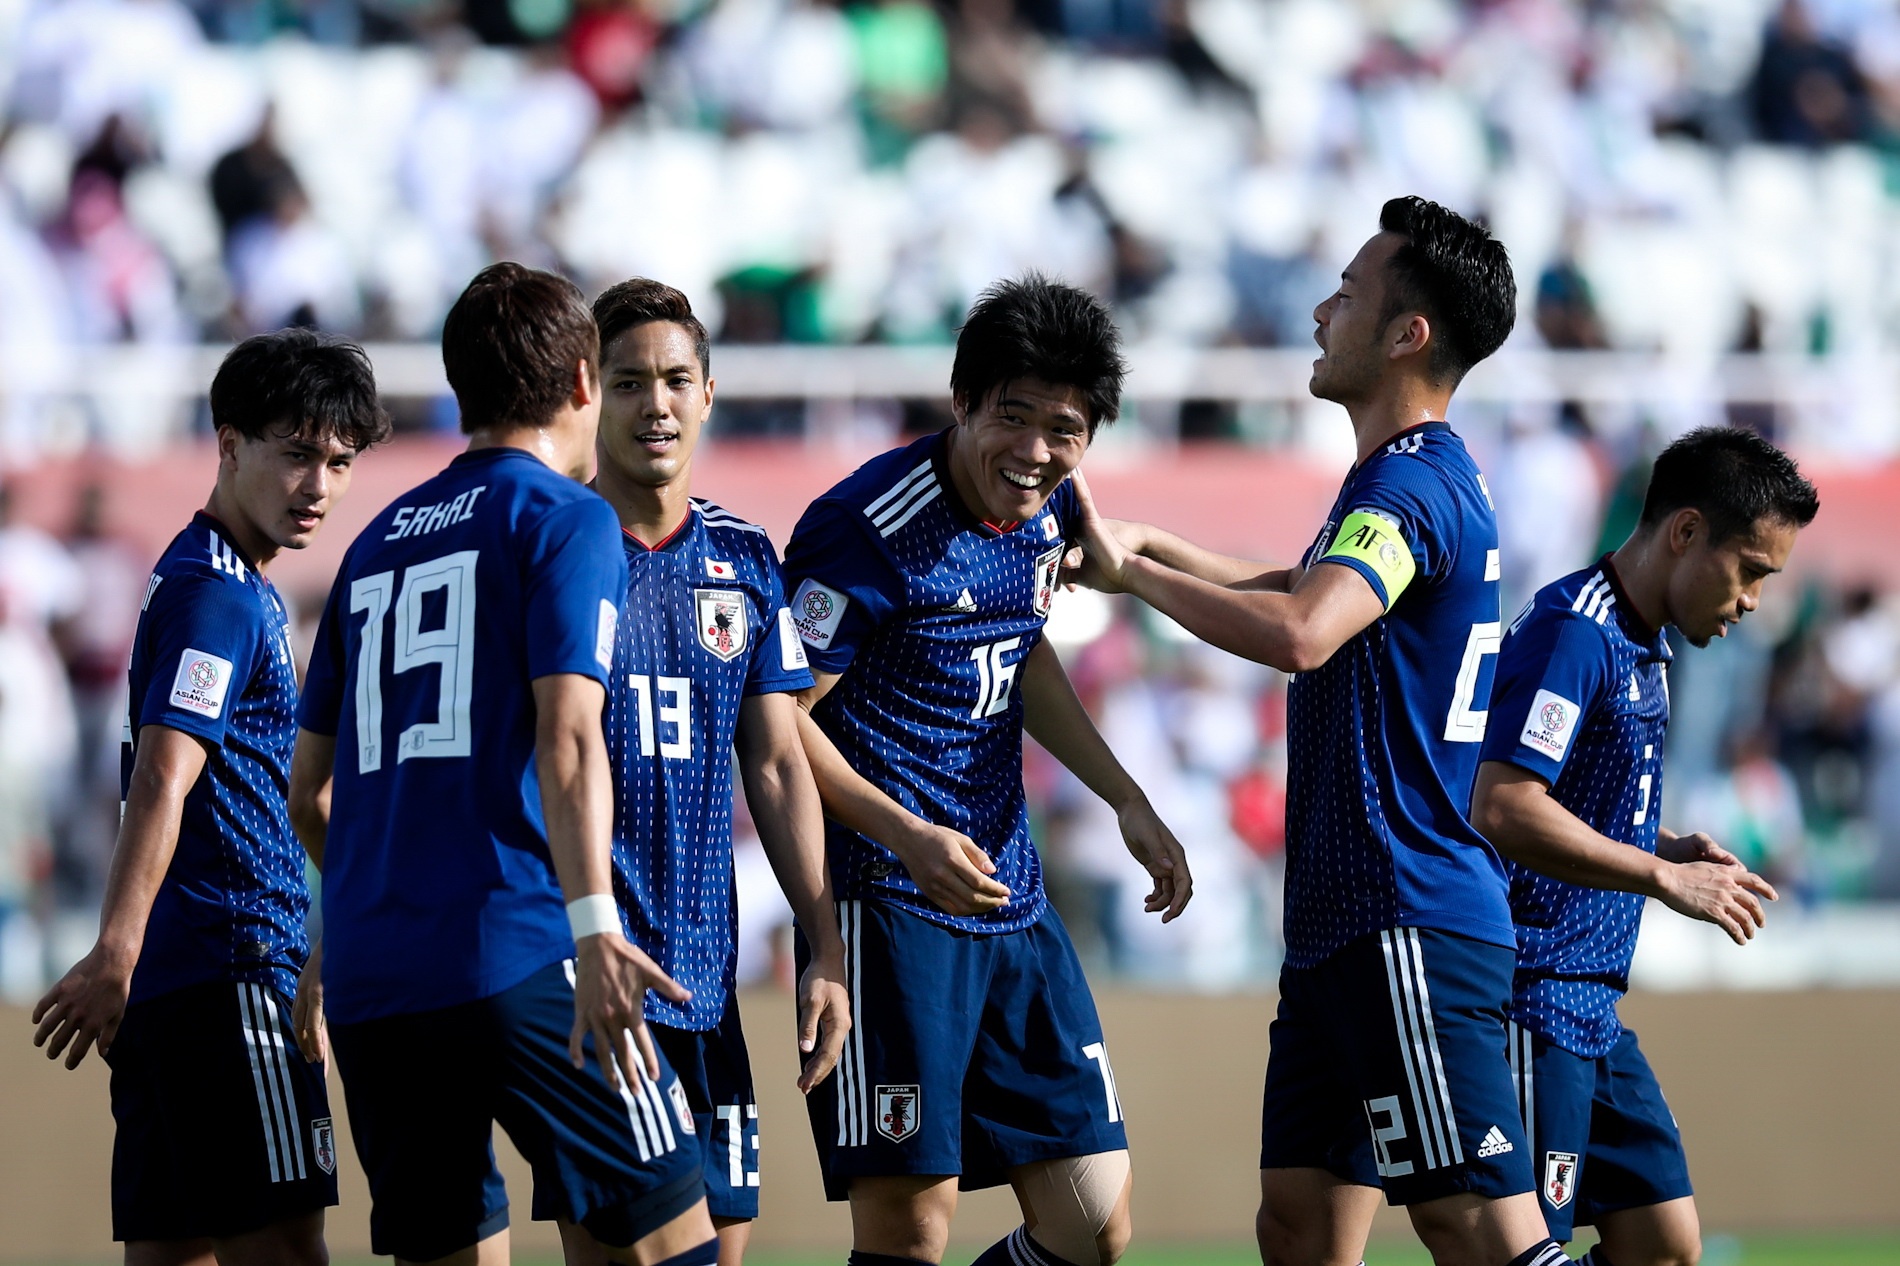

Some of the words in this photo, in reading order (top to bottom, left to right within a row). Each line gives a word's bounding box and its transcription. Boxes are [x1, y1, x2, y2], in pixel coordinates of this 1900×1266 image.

[384, 485, 487, 541] SAKAI
[709, 592, 733, 600] JAPAN
[803, 617, 817, 628] AFC
[811, 628, 829, 640] CUP
[350, 550, 480, 775] 19
[970, 637, 1021, 719] 16
[175, 690, 200, 702] ASIAN
[201, 697, 219, 707] CUP
[192, 689, 206, 697] AFC
[629, 673, 692, 760] 13
[1526, 729, 1550, 743] ASIAN
[1082, 1042, 1124, 1123] 1
[1364, 1094, 1414, 1178] 2
[1477, 1142, 1513, 1158] adidas
